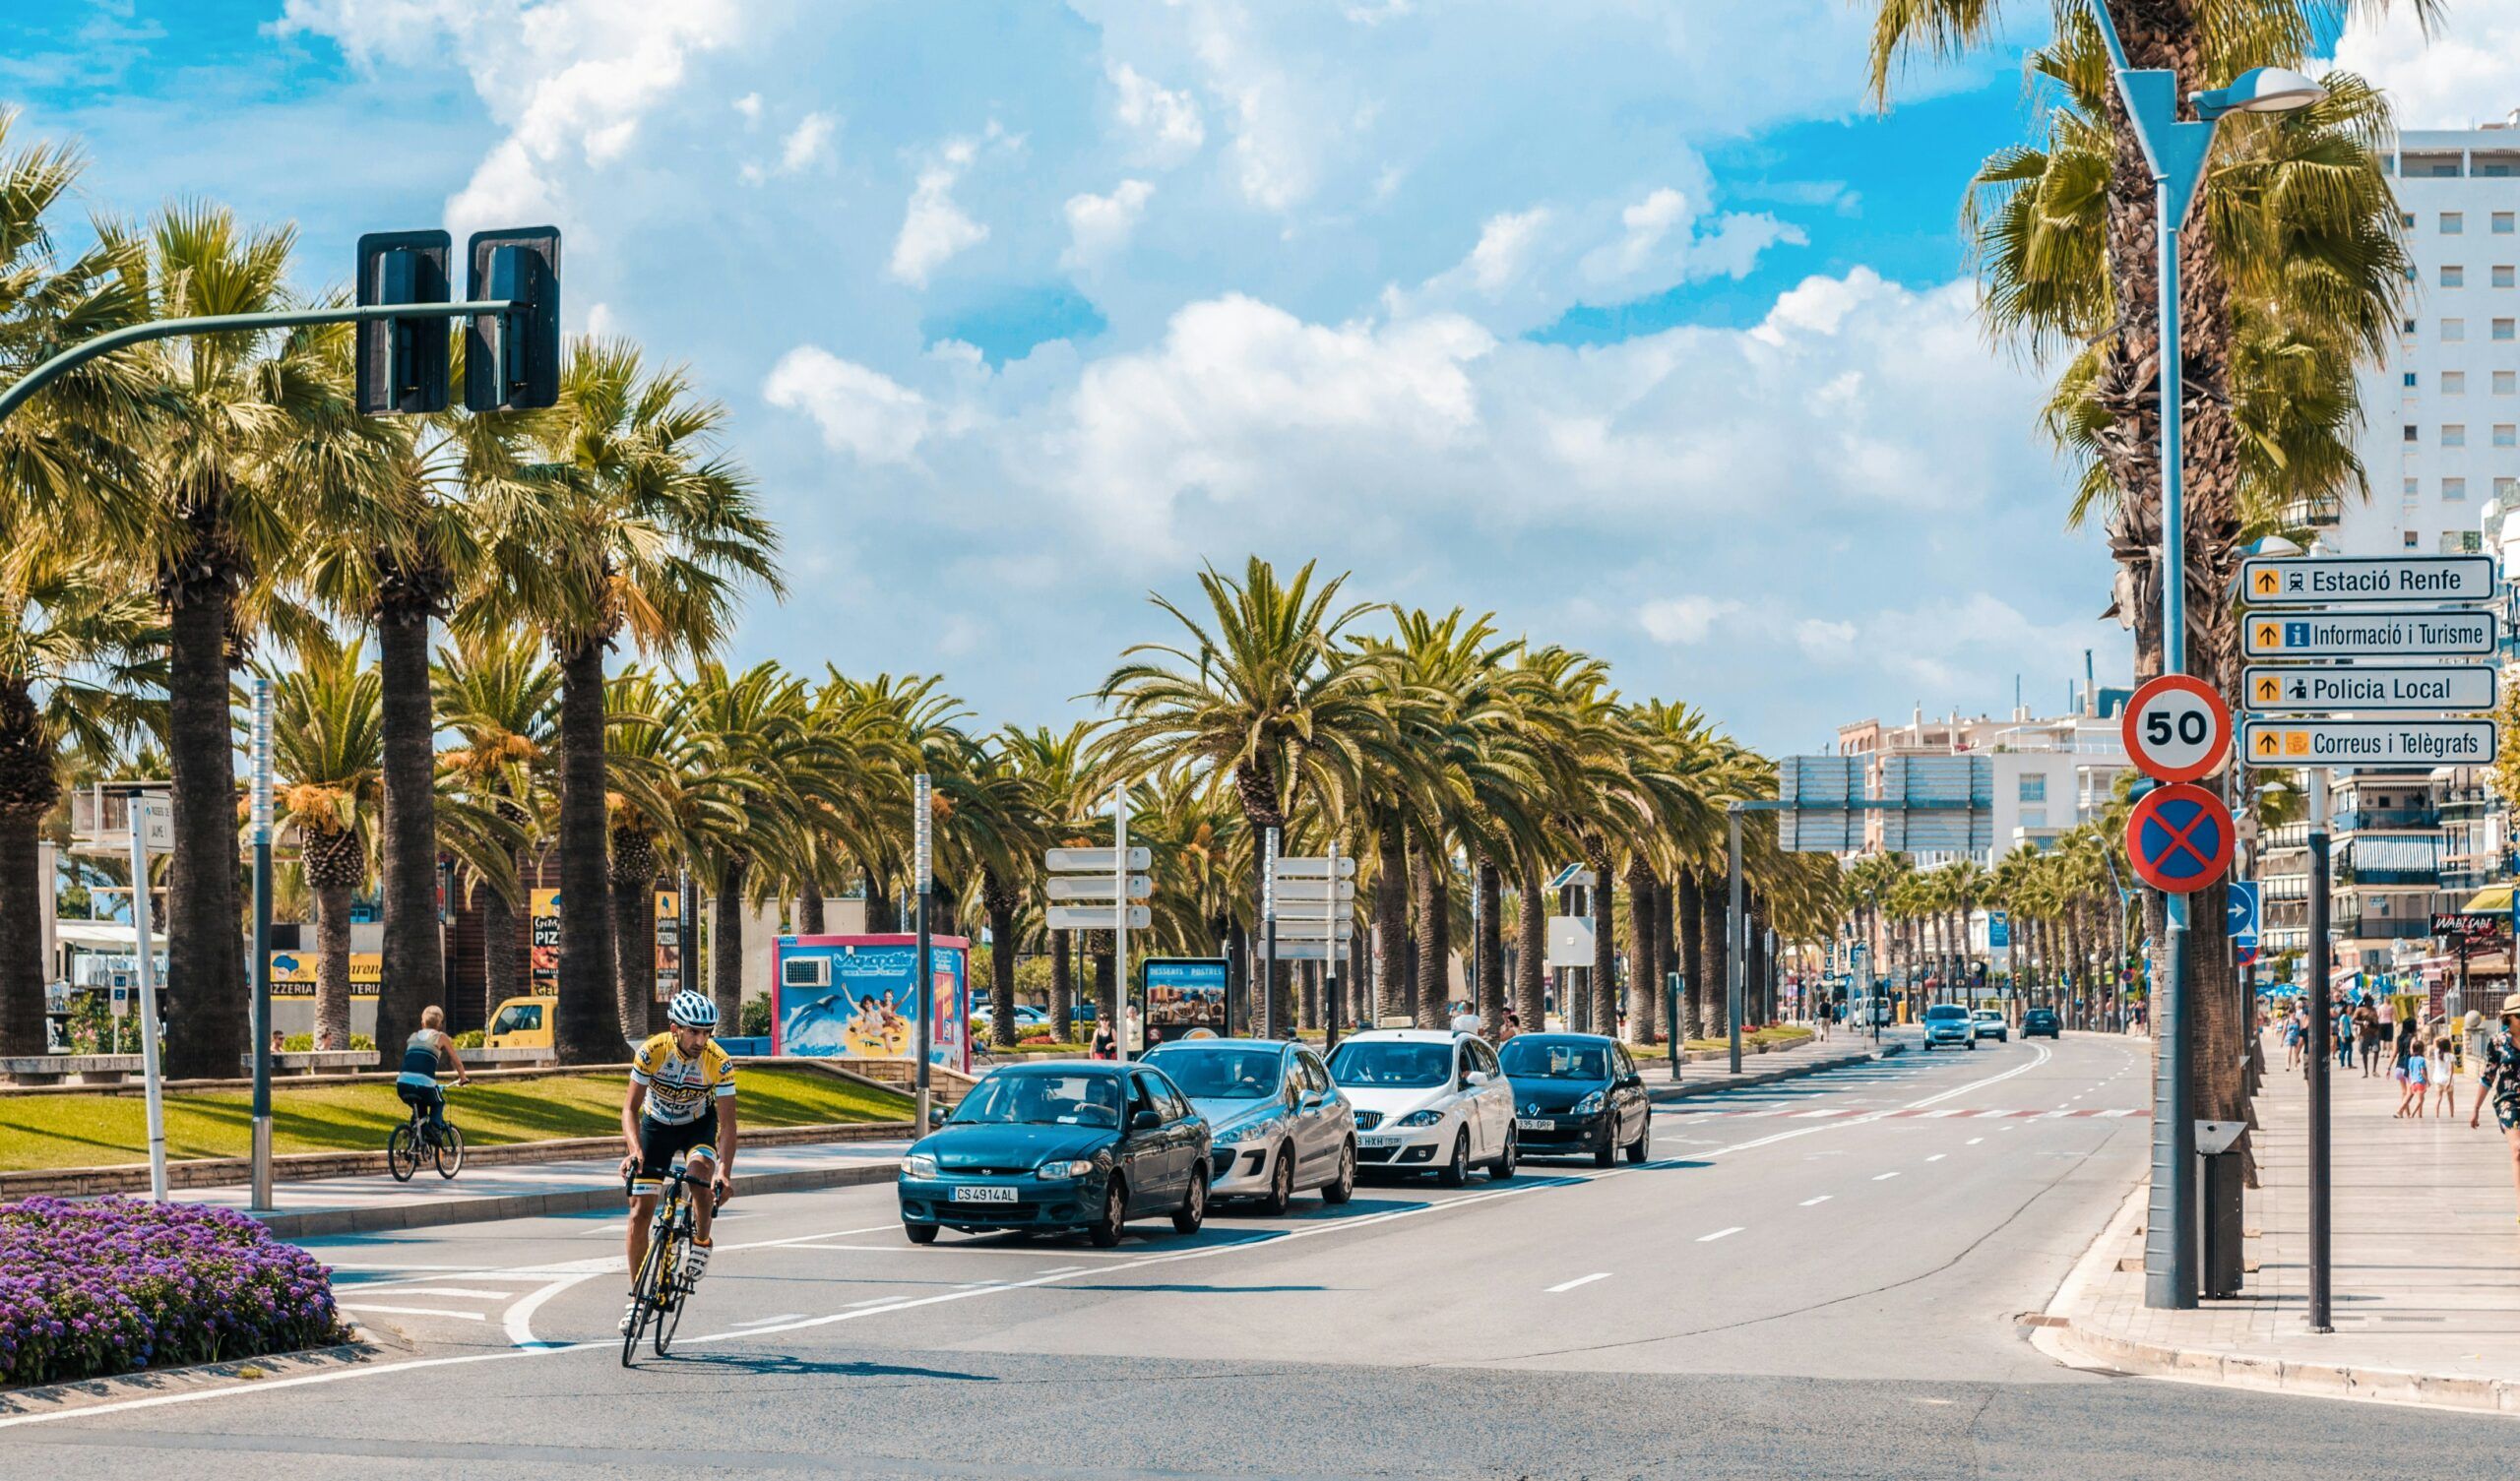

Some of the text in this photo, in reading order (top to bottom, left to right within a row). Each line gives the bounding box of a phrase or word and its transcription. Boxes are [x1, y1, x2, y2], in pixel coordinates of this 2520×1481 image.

[2313, 569, 2462, 592] Estació Renfe
[2313, 623, 2484, 646] Informació i Turisme
[2314, 678, 2451, 700] Policia Local
[2146, 710, 2207, 746] 50
[2313, 732, 2479, 758] Correus i Telègrafs
[2435, 916, 2492, 929] WABI SABI
[535, 931, 560, 946] PIZ
[270, 984, 313, 995] IZZERIA
